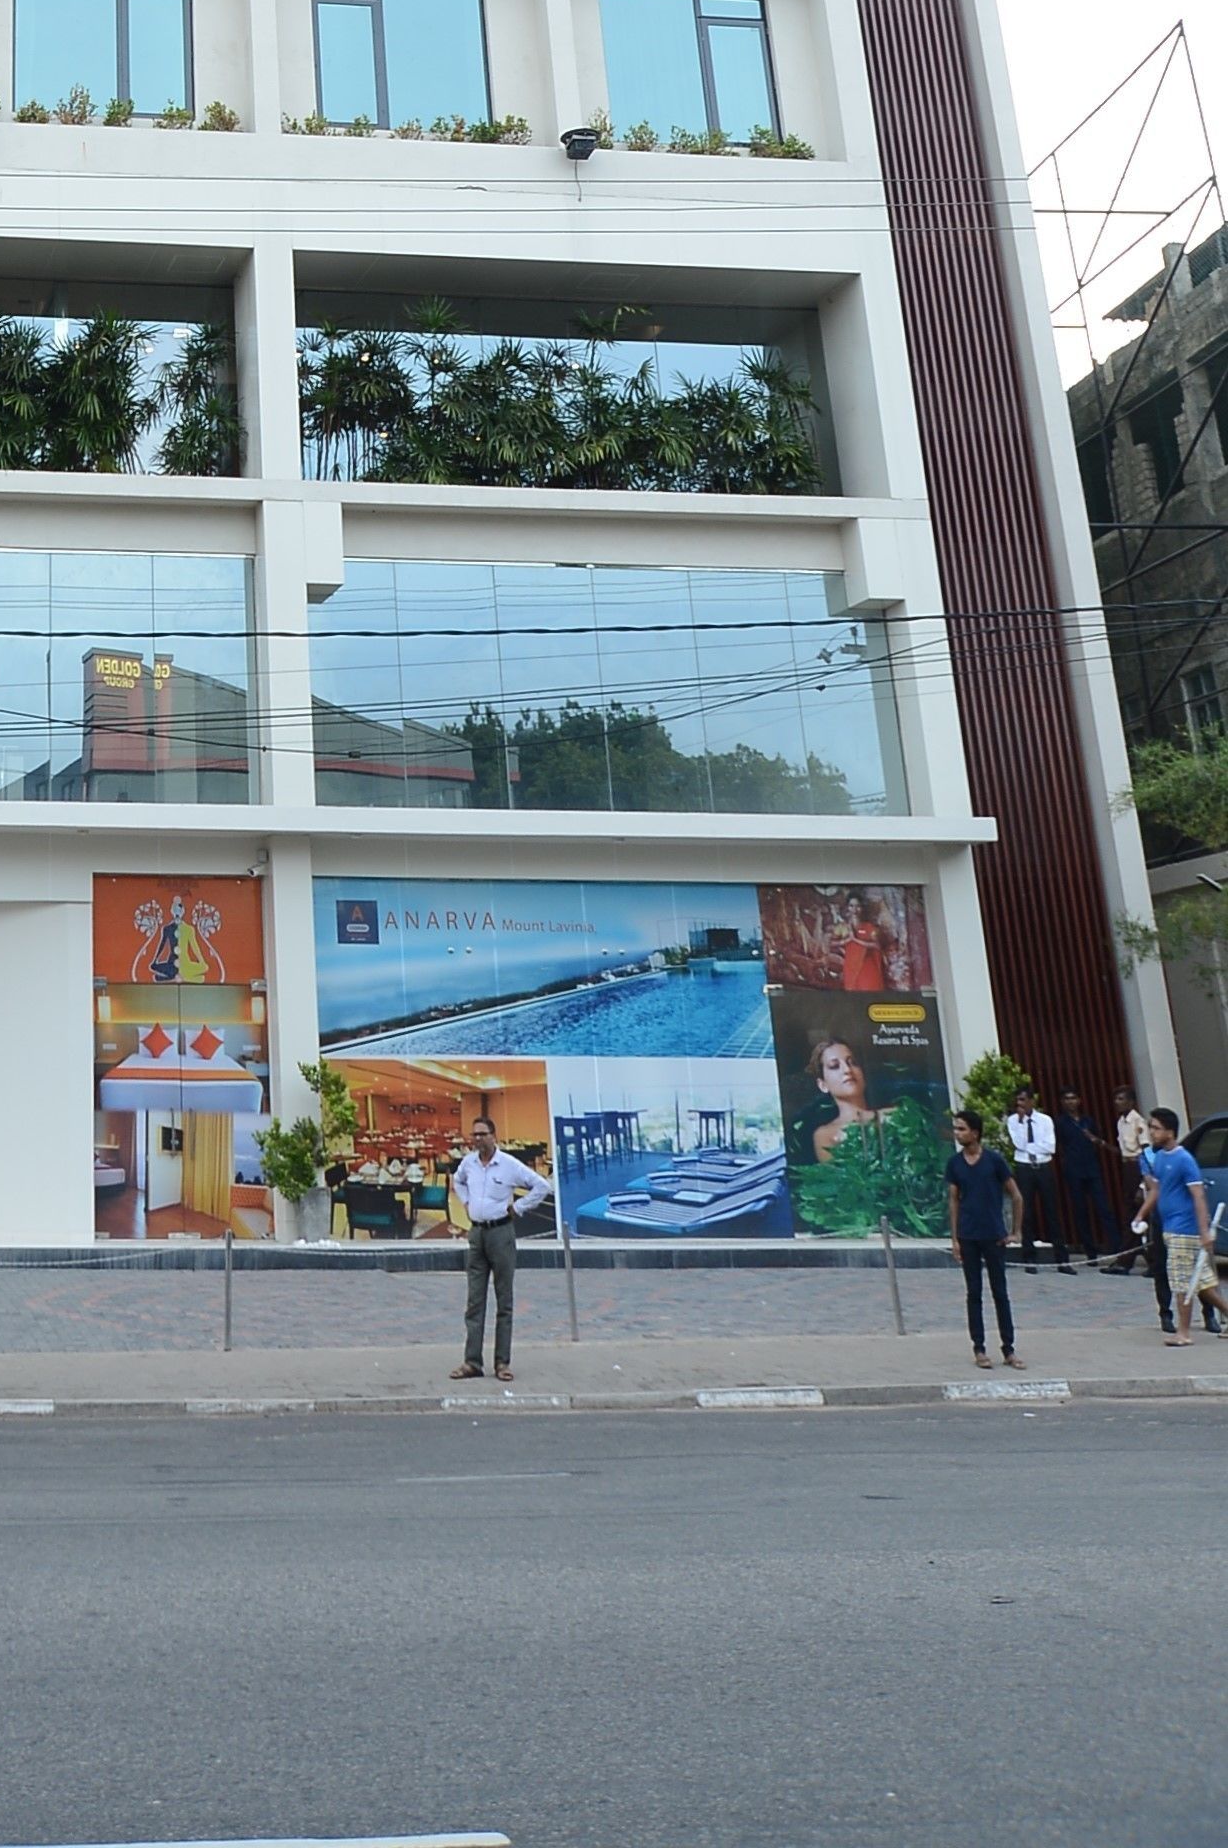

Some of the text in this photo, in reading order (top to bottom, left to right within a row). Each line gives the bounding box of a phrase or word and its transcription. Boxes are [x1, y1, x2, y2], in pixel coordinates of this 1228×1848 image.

[385, 911, 496, 930] ANARVA
[502, 919, 544, 933] Mount
[879, 1023, 919, 1035] Ayurveda
[902, 1035, 909, 1045] &
[910, 1034, 929, 1047] Spas
